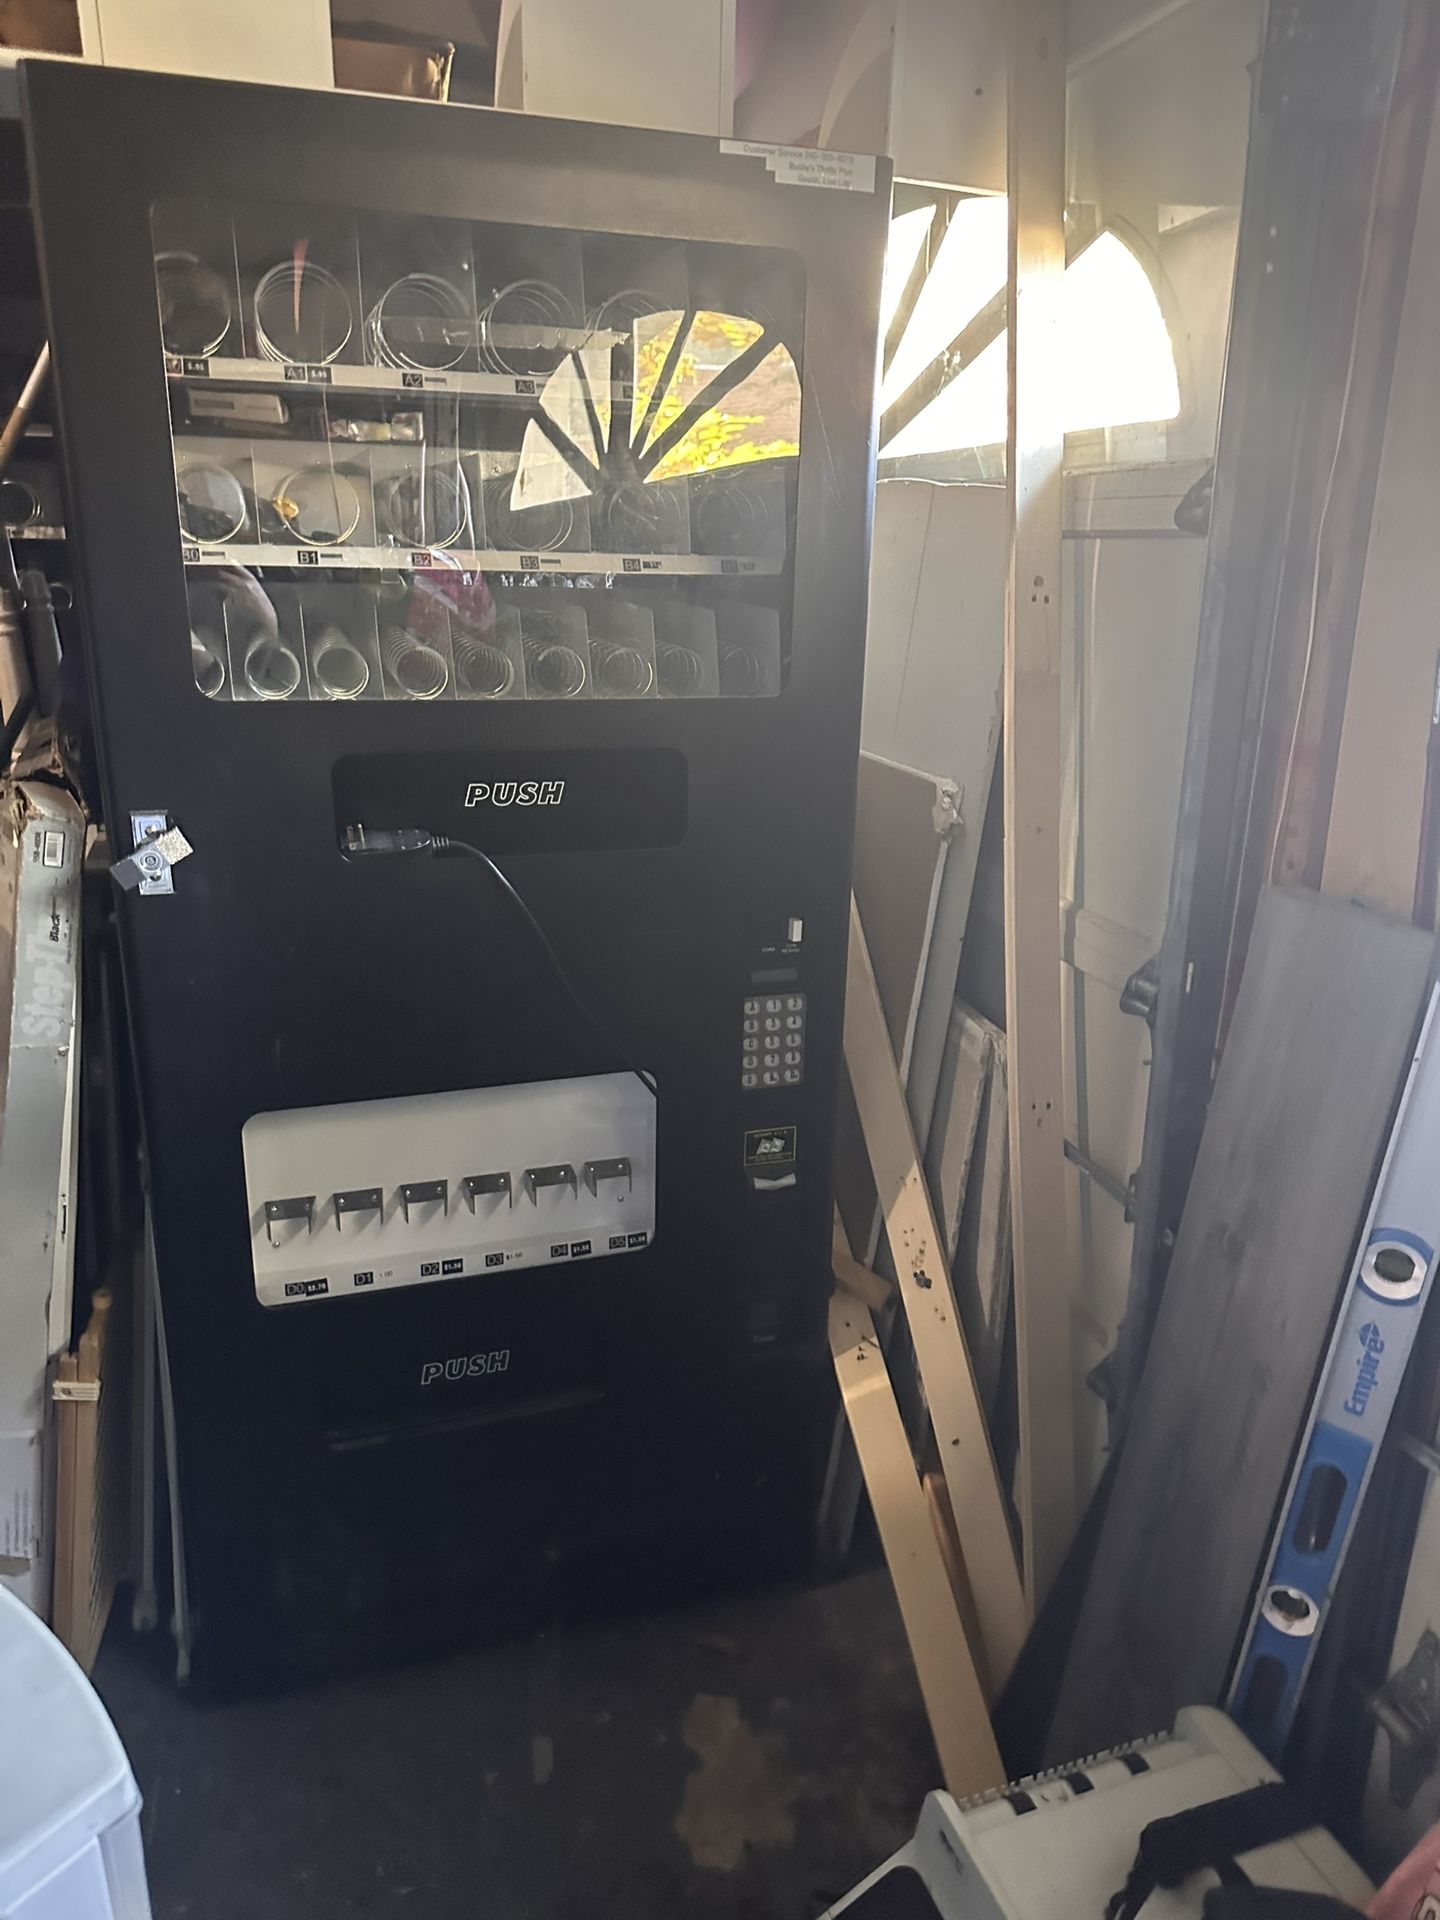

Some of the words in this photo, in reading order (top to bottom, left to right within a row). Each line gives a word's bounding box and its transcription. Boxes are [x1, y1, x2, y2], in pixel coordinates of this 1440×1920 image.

[743, 144, 776, 156] Customer
[778, 147, 803, 159] Service
[286, 366, 304, 380] A1
[404, 374, 422, 387] A2
[517, 381, 535, 393] A3
[300, 552, 317, 563] B1
[413, 554, 431, 567] B2
[522, 556, 538, 569] B3
[624, 559, 641, 571] B4
[464, 781, 564, 807] PUSH
[552, 1245, 567, 1257] D4
[487, 1254, 503, 1265] D3
[422, 1263, 439, 1275] D2
[355, 1273, 372, 1284] D1
[286, 1283, 304, 1295] D0
[420, 1349, 510, 1386] PUSH
[1343, 1339, 1385, 1417] Empire
